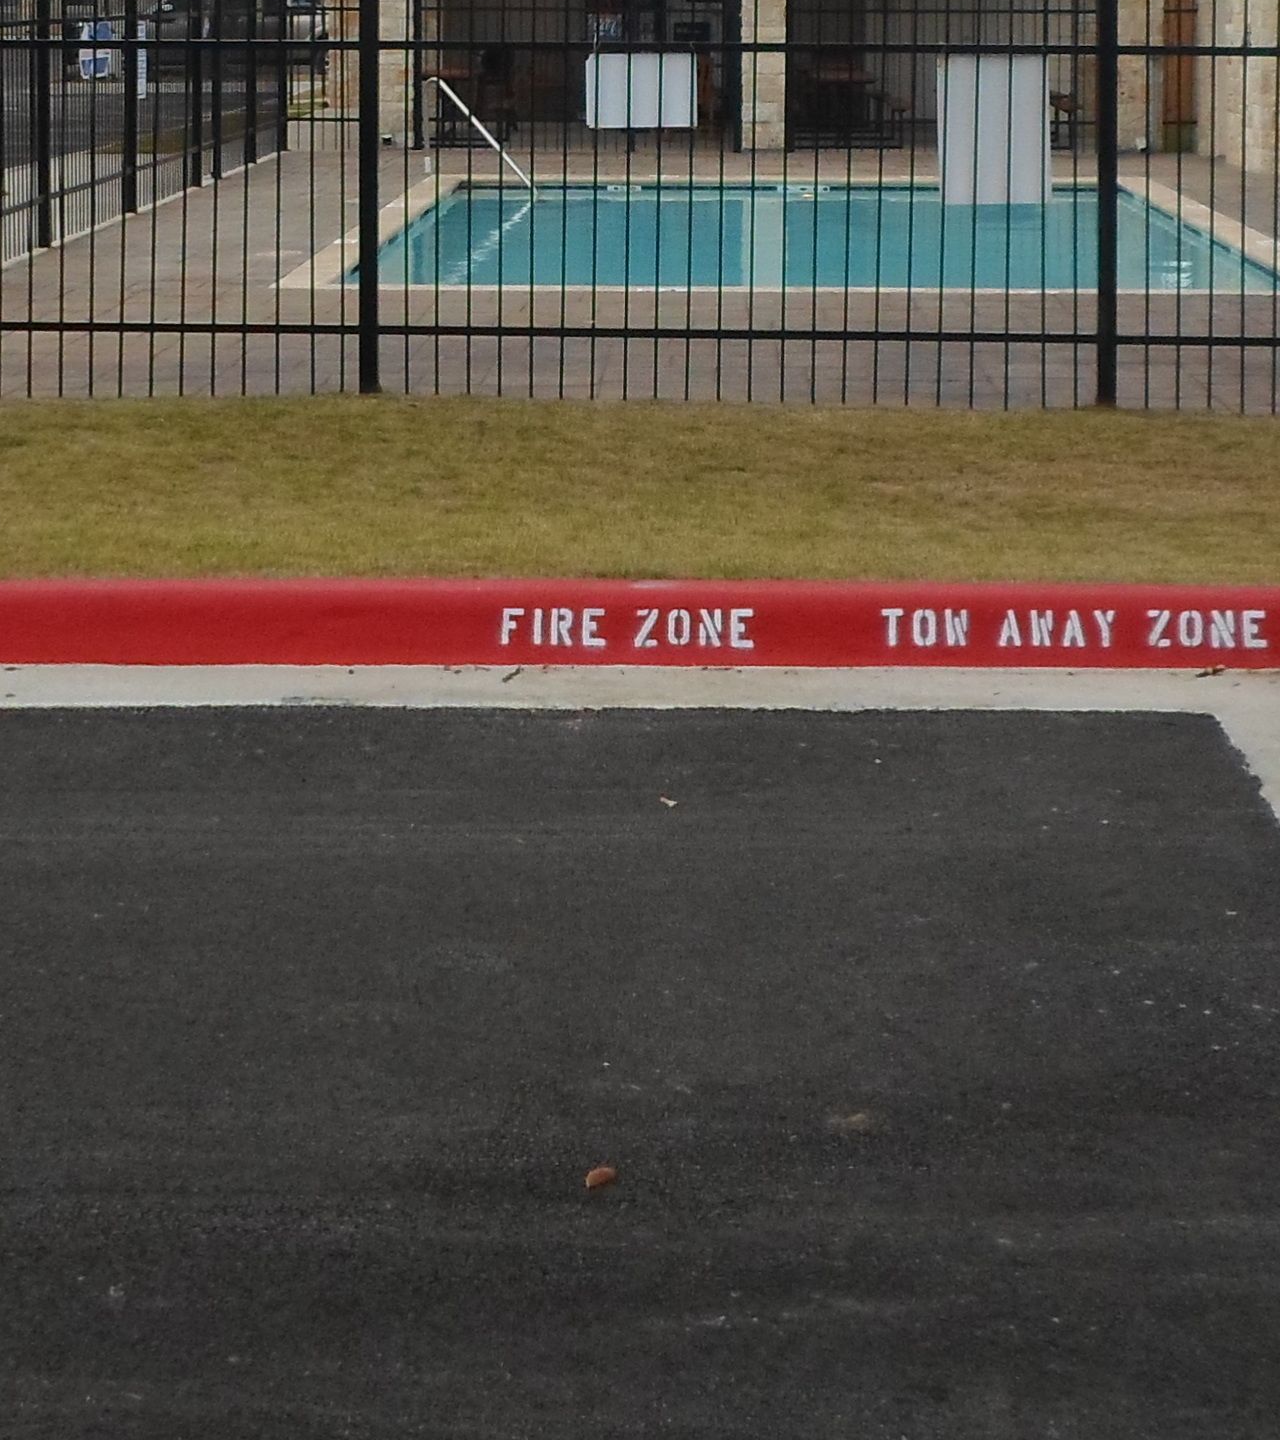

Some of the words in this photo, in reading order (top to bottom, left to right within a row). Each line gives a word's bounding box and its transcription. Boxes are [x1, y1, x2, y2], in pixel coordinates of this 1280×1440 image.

[500, 607, 606, 647] FIRE
[633, 608, 755, 648] ZONE
[881, 608, 968, 647] TOW
[997, 608, 1115, 648] AWAY
[1147, 609, 1268, 648] ZONE
